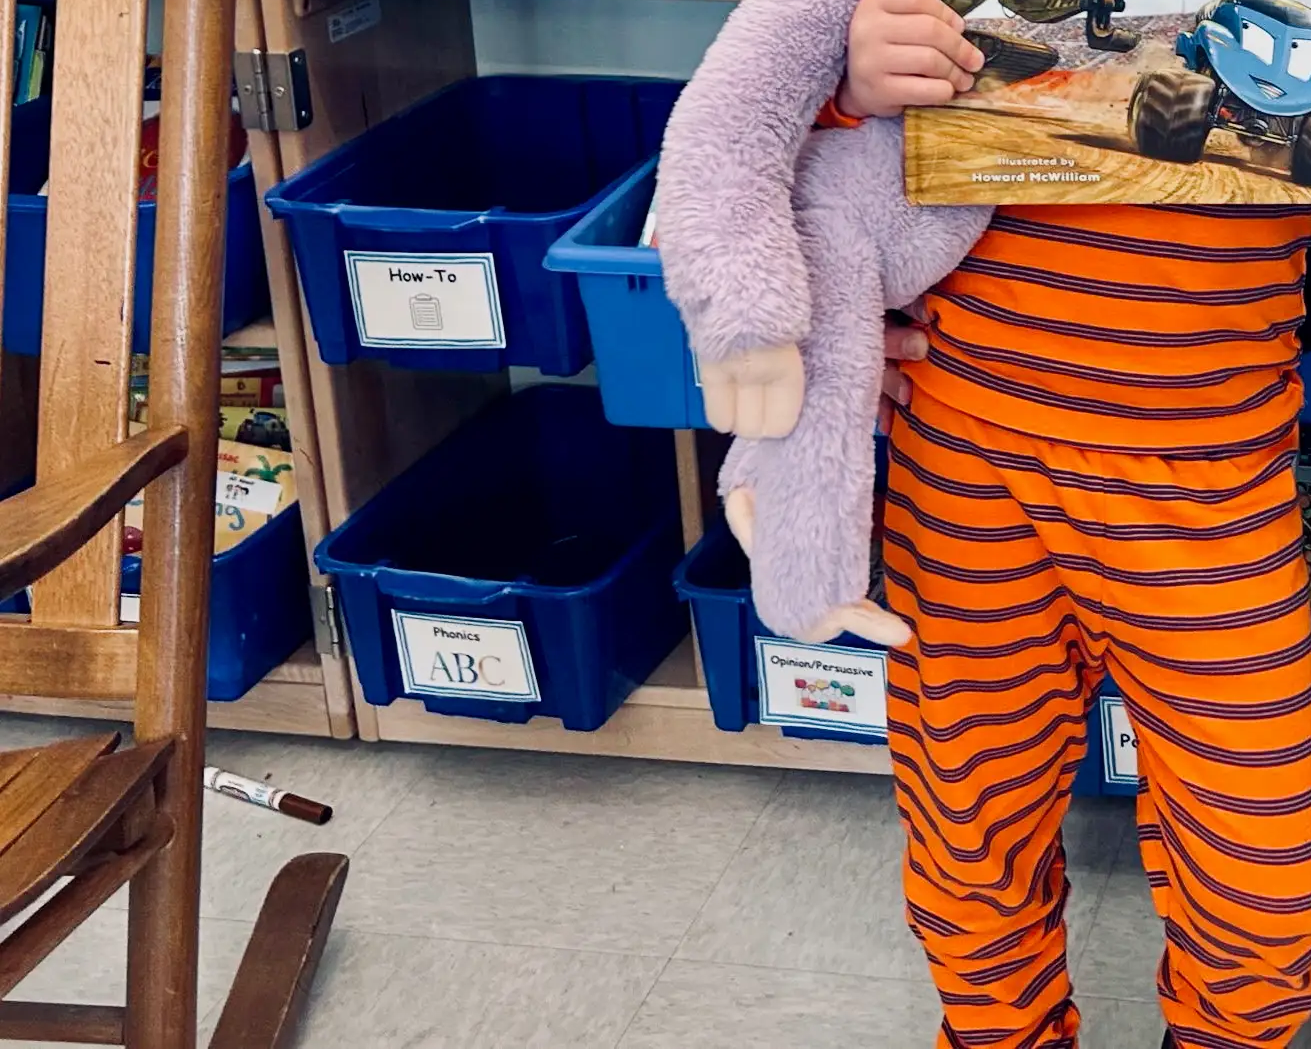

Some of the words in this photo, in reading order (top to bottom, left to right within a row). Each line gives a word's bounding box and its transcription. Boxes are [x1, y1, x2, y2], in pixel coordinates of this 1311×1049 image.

[997, 158, 1057, 166] Illustrated
[1060, 158, 1075, 167] by
[972, 173, 1025, 182] Howard
[1029, 173, 1100, 182] McWilliam
[389, 267, 457, 282] How-To
[433, 626, 481, 642] Phonics
[430, 651, 506, 686] ABC
[770, 655, 874, 677] Opinion/Persuasive
